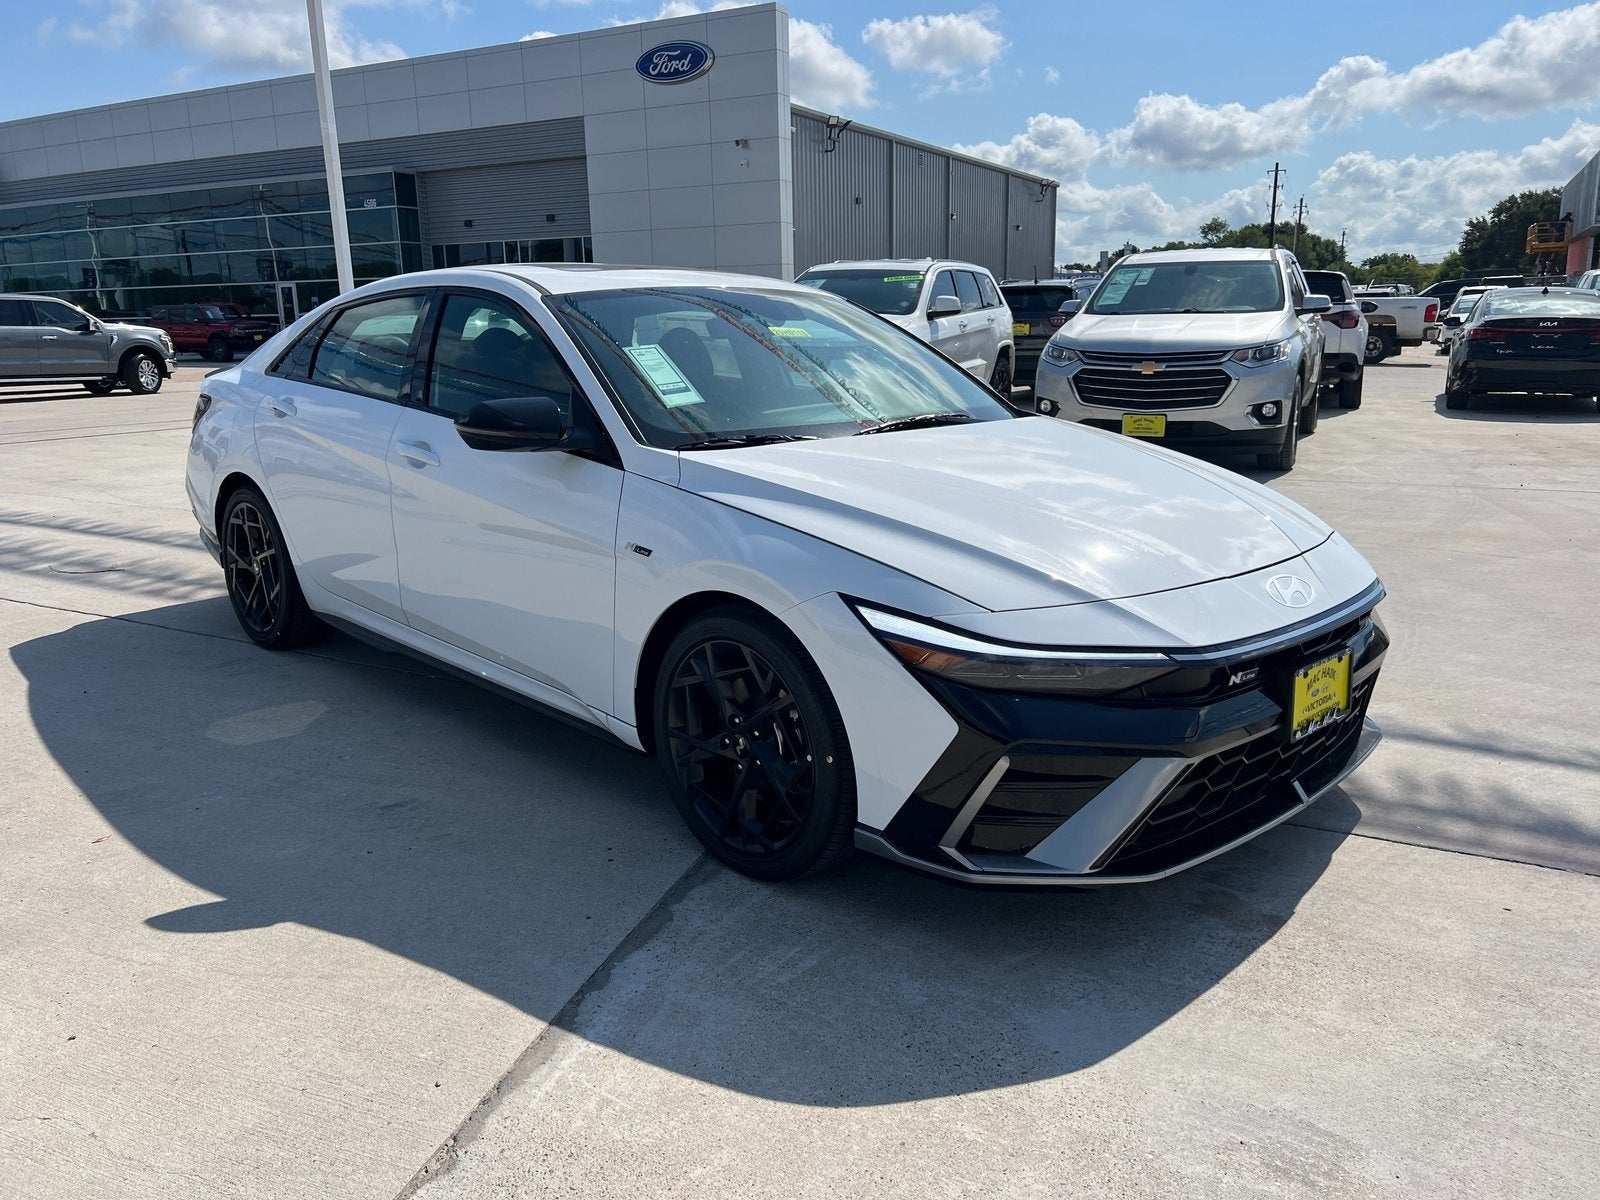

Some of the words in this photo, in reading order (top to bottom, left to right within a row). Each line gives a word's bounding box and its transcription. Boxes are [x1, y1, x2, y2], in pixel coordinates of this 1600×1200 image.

[649, 51, 692, 75] Ford
[1229, 671, 1243, 686] N
[1306, 669, 1321, 695] MAC
